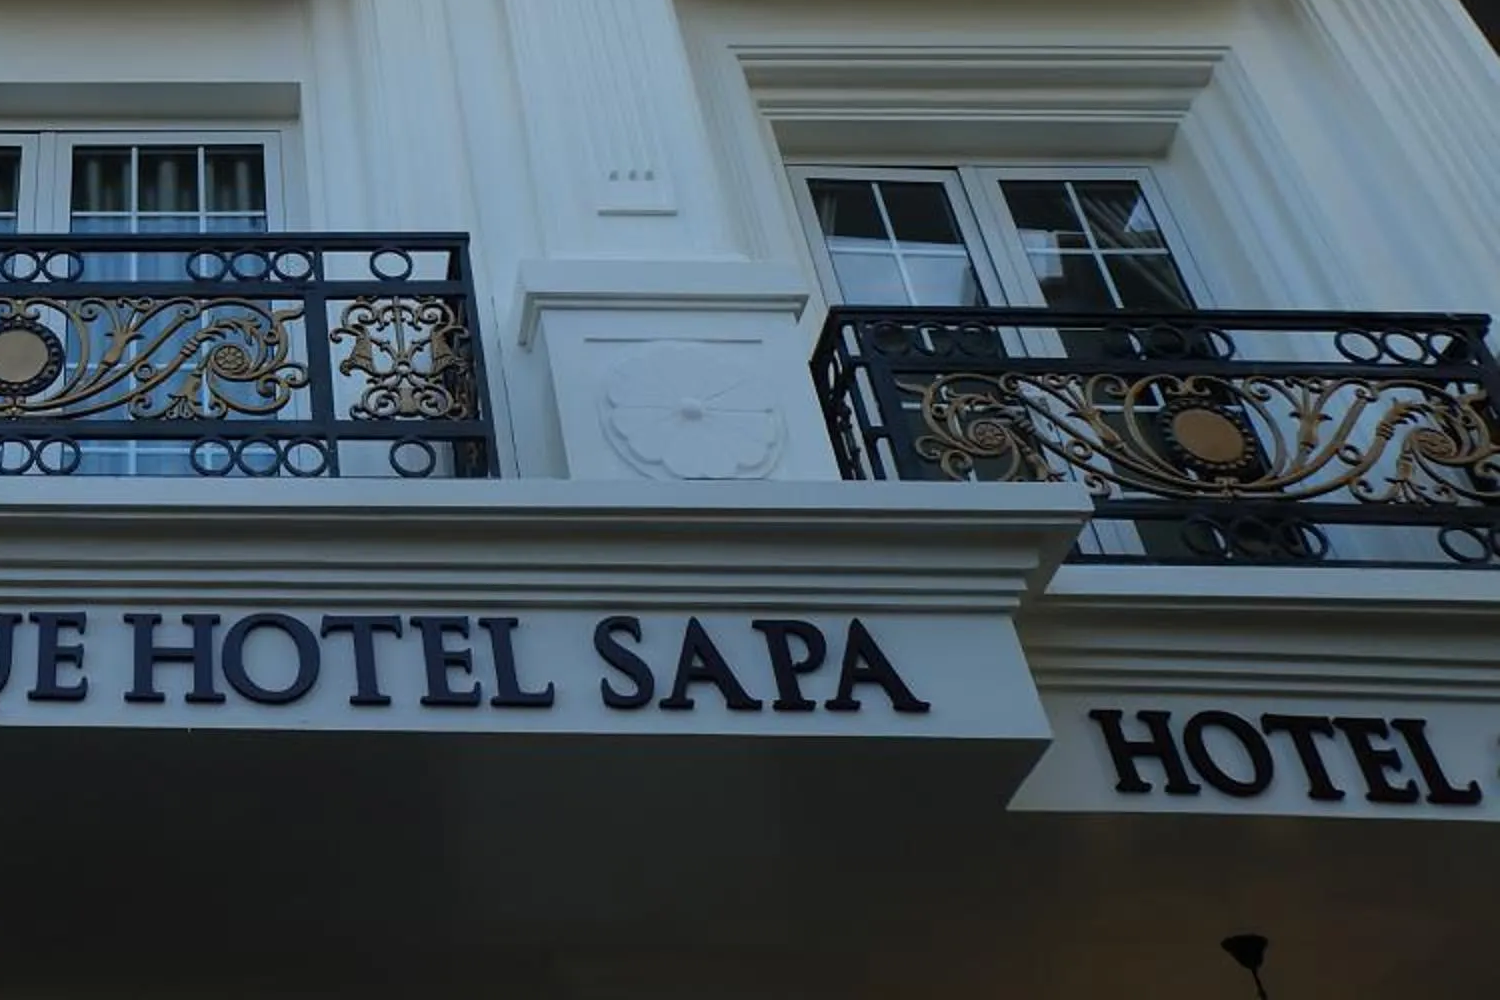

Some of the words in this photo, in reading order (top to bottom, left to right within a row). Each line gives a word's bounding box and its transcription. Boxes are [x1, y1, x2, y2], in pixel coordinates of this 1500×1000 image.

[123, 611, 556, 708] HOTEL
[593, 615, 932, 713] SAPA
[1088, 708, 1483, 805] HOTEL
